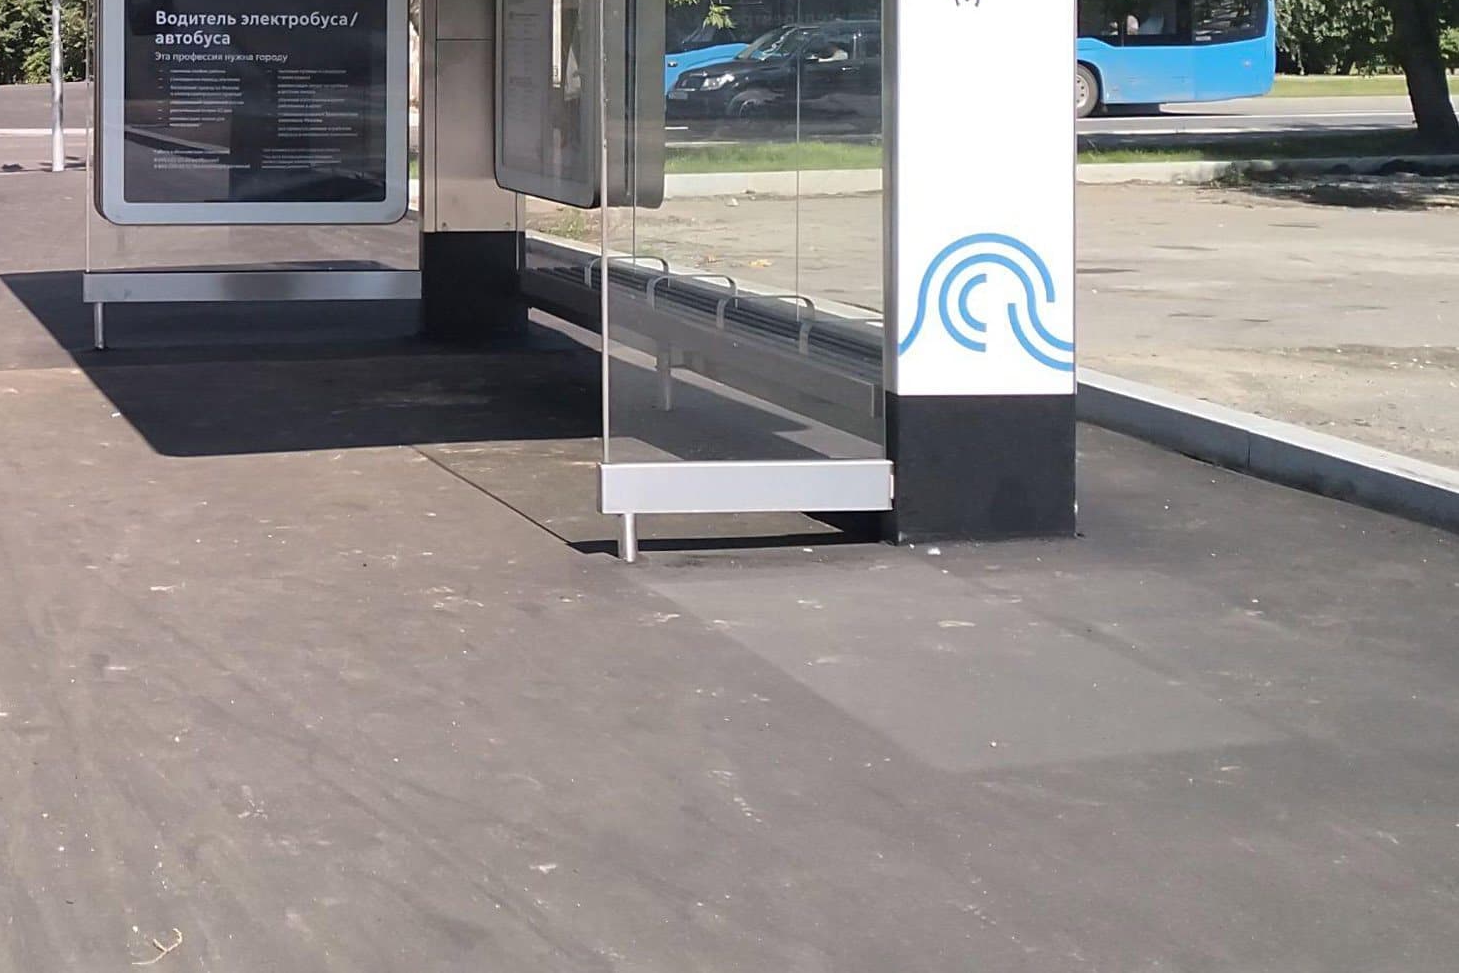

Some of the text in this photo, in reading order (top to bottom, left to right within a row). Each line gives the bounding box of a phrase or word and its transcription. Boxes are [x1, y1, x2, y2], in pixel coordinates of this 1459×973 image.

[155, 11, 359, 29] Водитель электробуса/
[155, 31, 231, 48] автобуса
[155, 51, 288, 63] Эта профессия нужна городу
